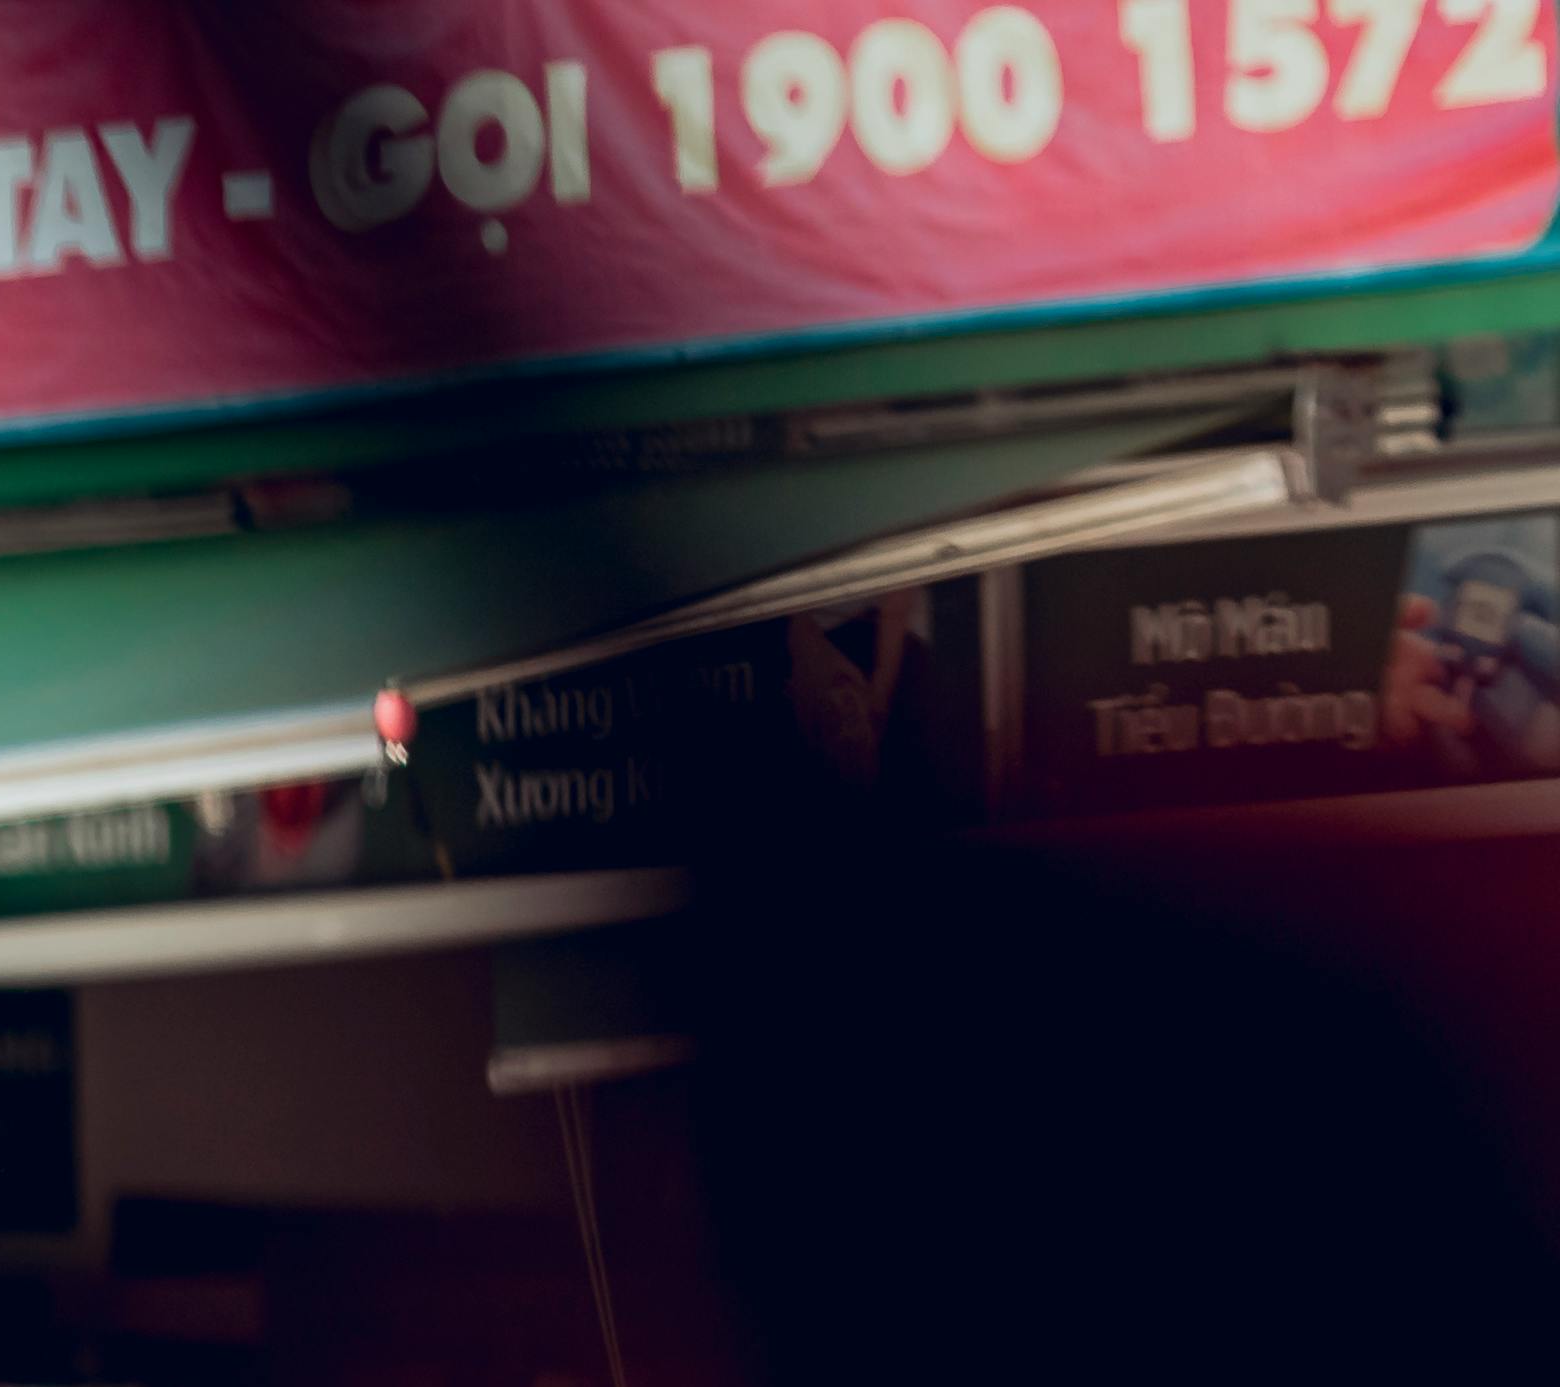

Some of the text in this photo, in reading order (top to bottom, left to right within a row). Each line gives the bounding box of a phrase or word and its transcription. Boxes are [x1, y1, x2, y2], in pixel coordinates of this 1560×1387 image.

[309, 58, 592, 255] GỌI
[652, 4, 1067, 198] 1900
[1125, 0, 1549, 142] 1572
